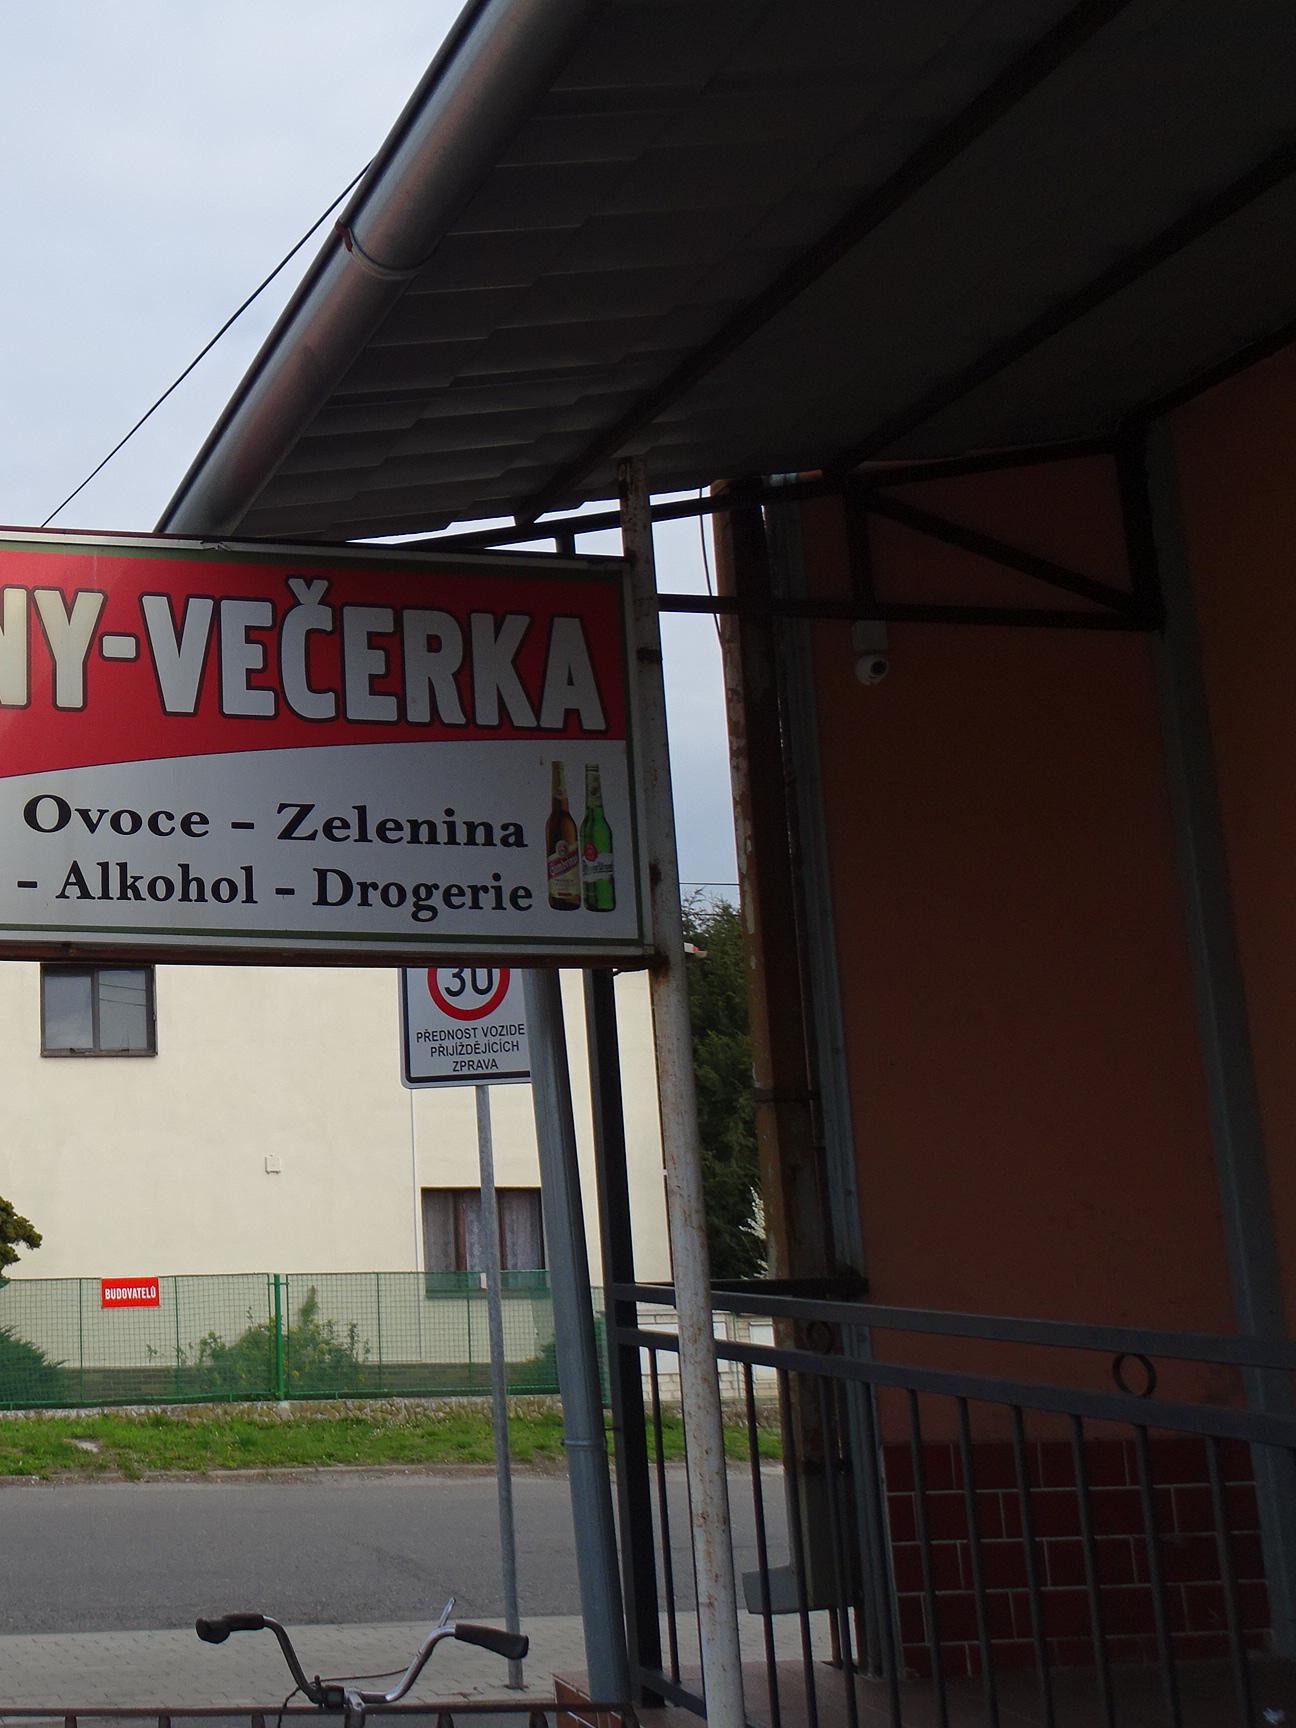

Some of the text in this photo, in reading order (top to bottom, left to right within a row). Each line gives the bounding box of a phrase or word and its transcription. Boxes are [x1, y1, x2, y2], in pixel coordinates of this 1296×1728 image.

[23, 793, 210, 838] Ovoce
[276, 802, 529, 848] Zelenina
[55, 860, 259, 905] Alkohol
[312, 867, 533, 923] Drogerie
[444, 968, 494, 997] 30
[416, 1023, 526, 1043] PŘEDNOST VOZIDE
[430, 1039, 520, 1058] PŘIJÍŽDĚJÍCÍCH
[452, 1058, 499, 1073] ZPRAVA
[105, 1286, 156, 1300] BUDOVATELŮ
